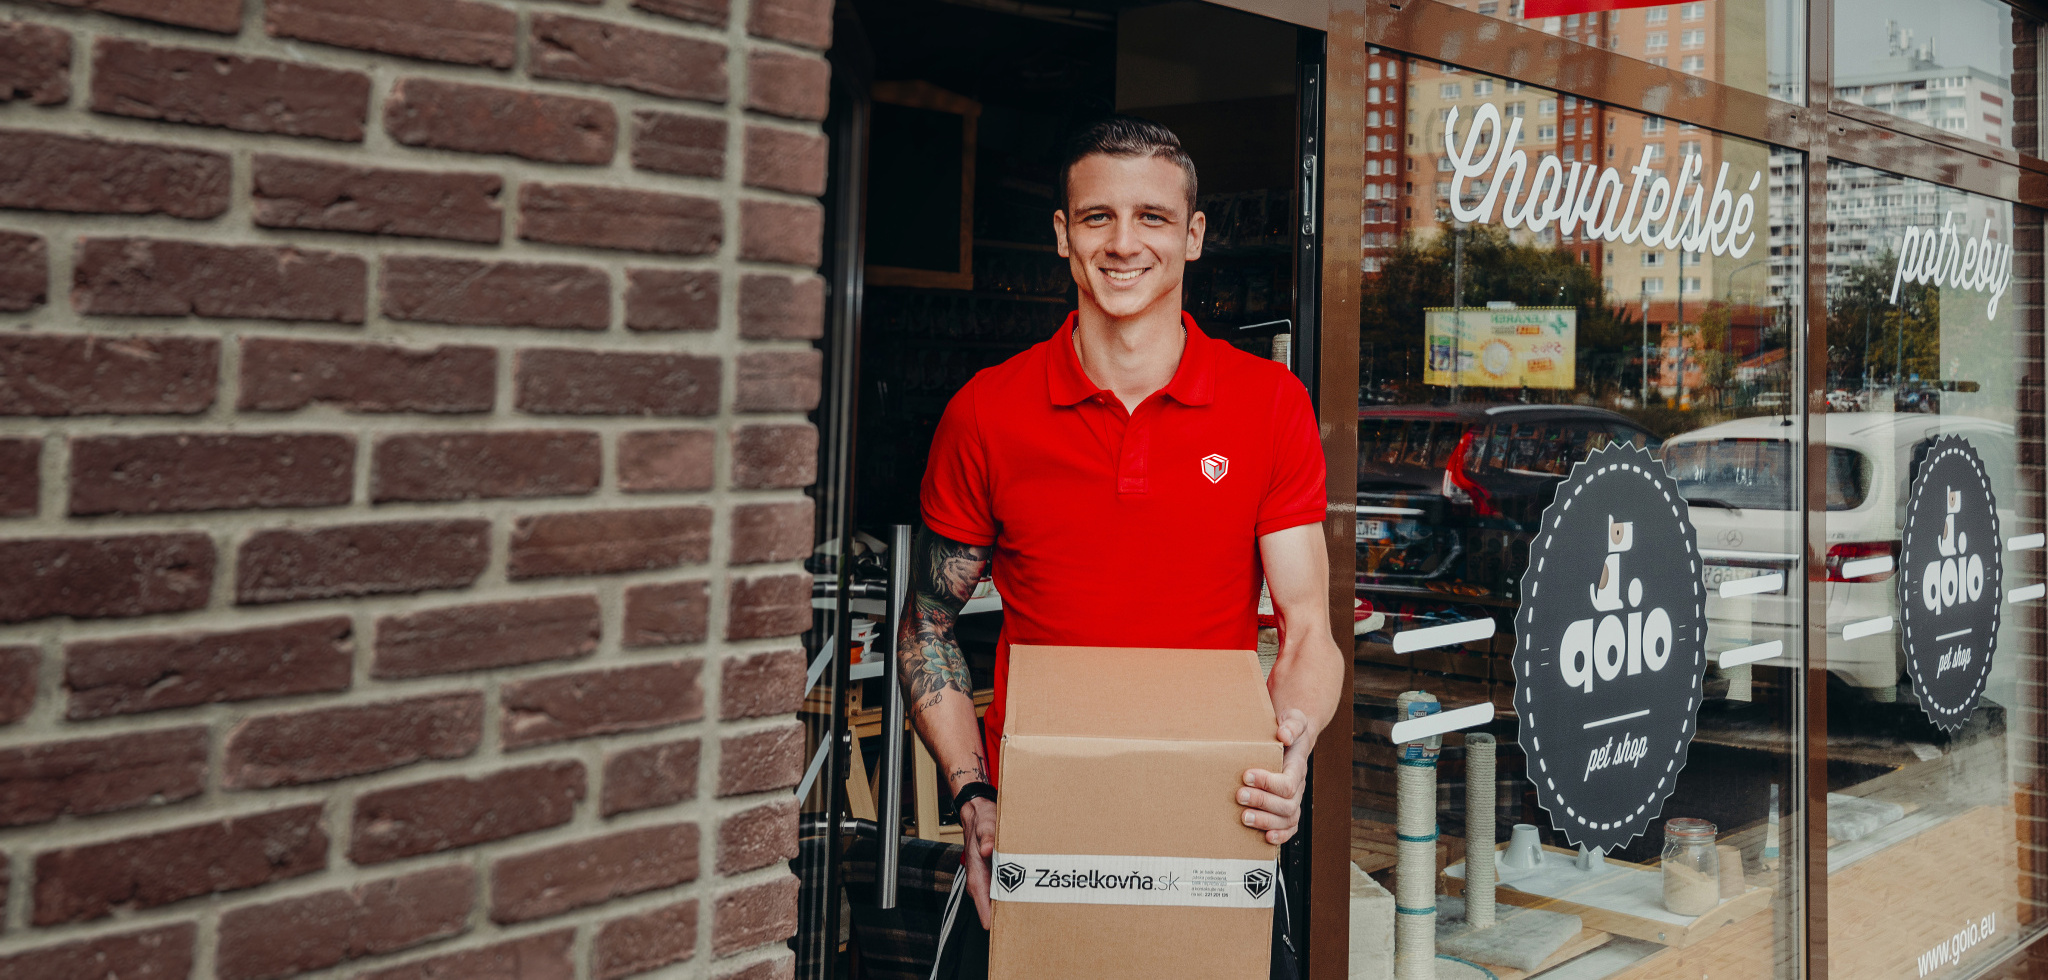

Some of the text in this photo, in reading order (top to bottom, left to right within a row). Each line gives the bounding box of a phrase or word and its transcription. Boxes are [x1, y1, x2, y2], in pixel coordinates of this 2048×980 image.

[1445, 102, 2010, 321] Chovateľské potreby
[1936, 644, 1972, 680] pet shop
[1583, 732, 1648, 782] pet shop
[1917, 911, 1996, 979] www.goio.eu
